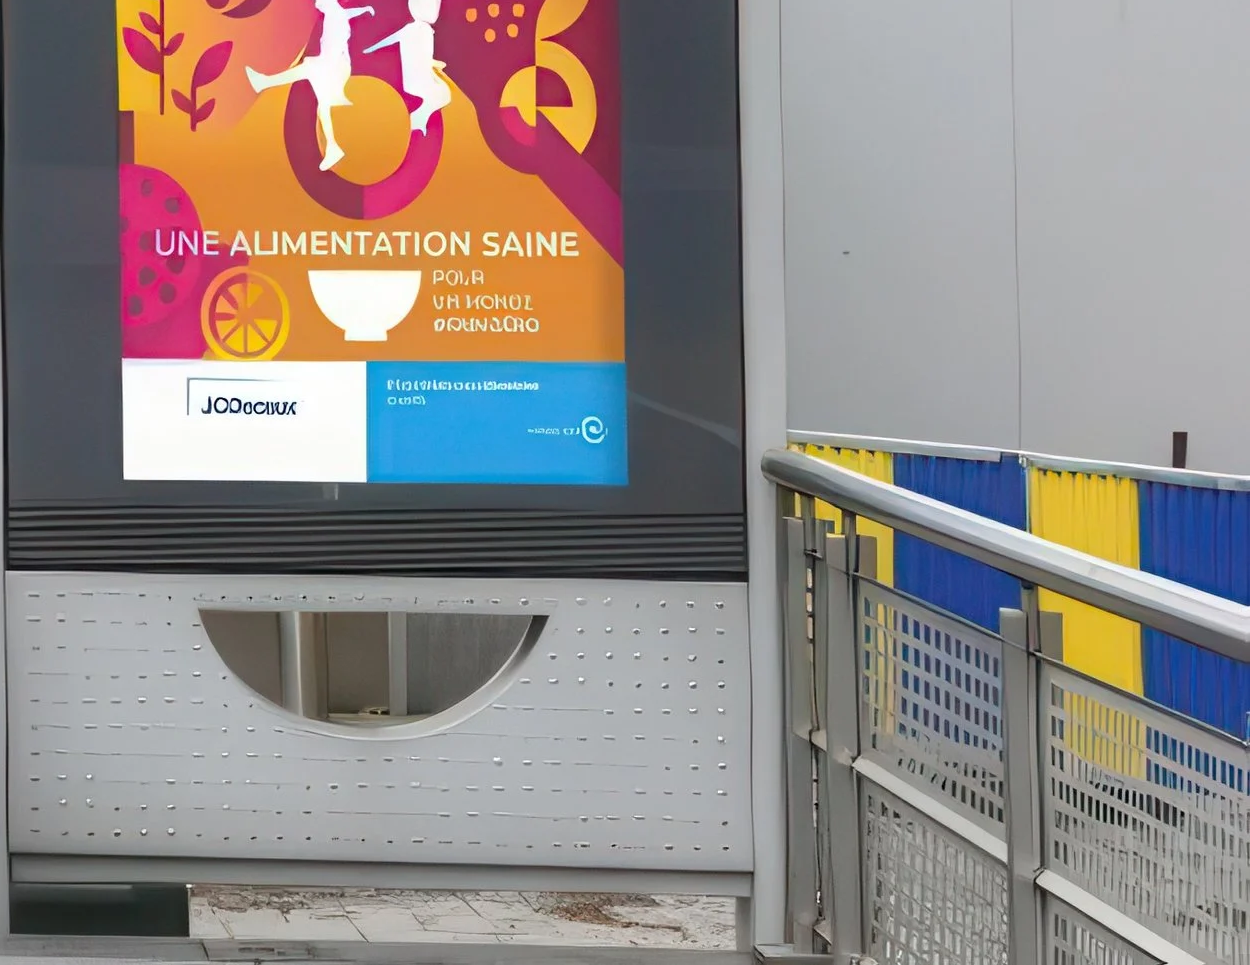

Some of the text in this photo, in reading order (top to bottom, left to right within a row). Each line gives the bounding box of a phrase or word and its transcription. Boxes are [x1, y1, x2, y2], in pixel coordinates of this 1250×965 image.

[155, 229, 580, 257] UNE ALIMENTATION SAINE
